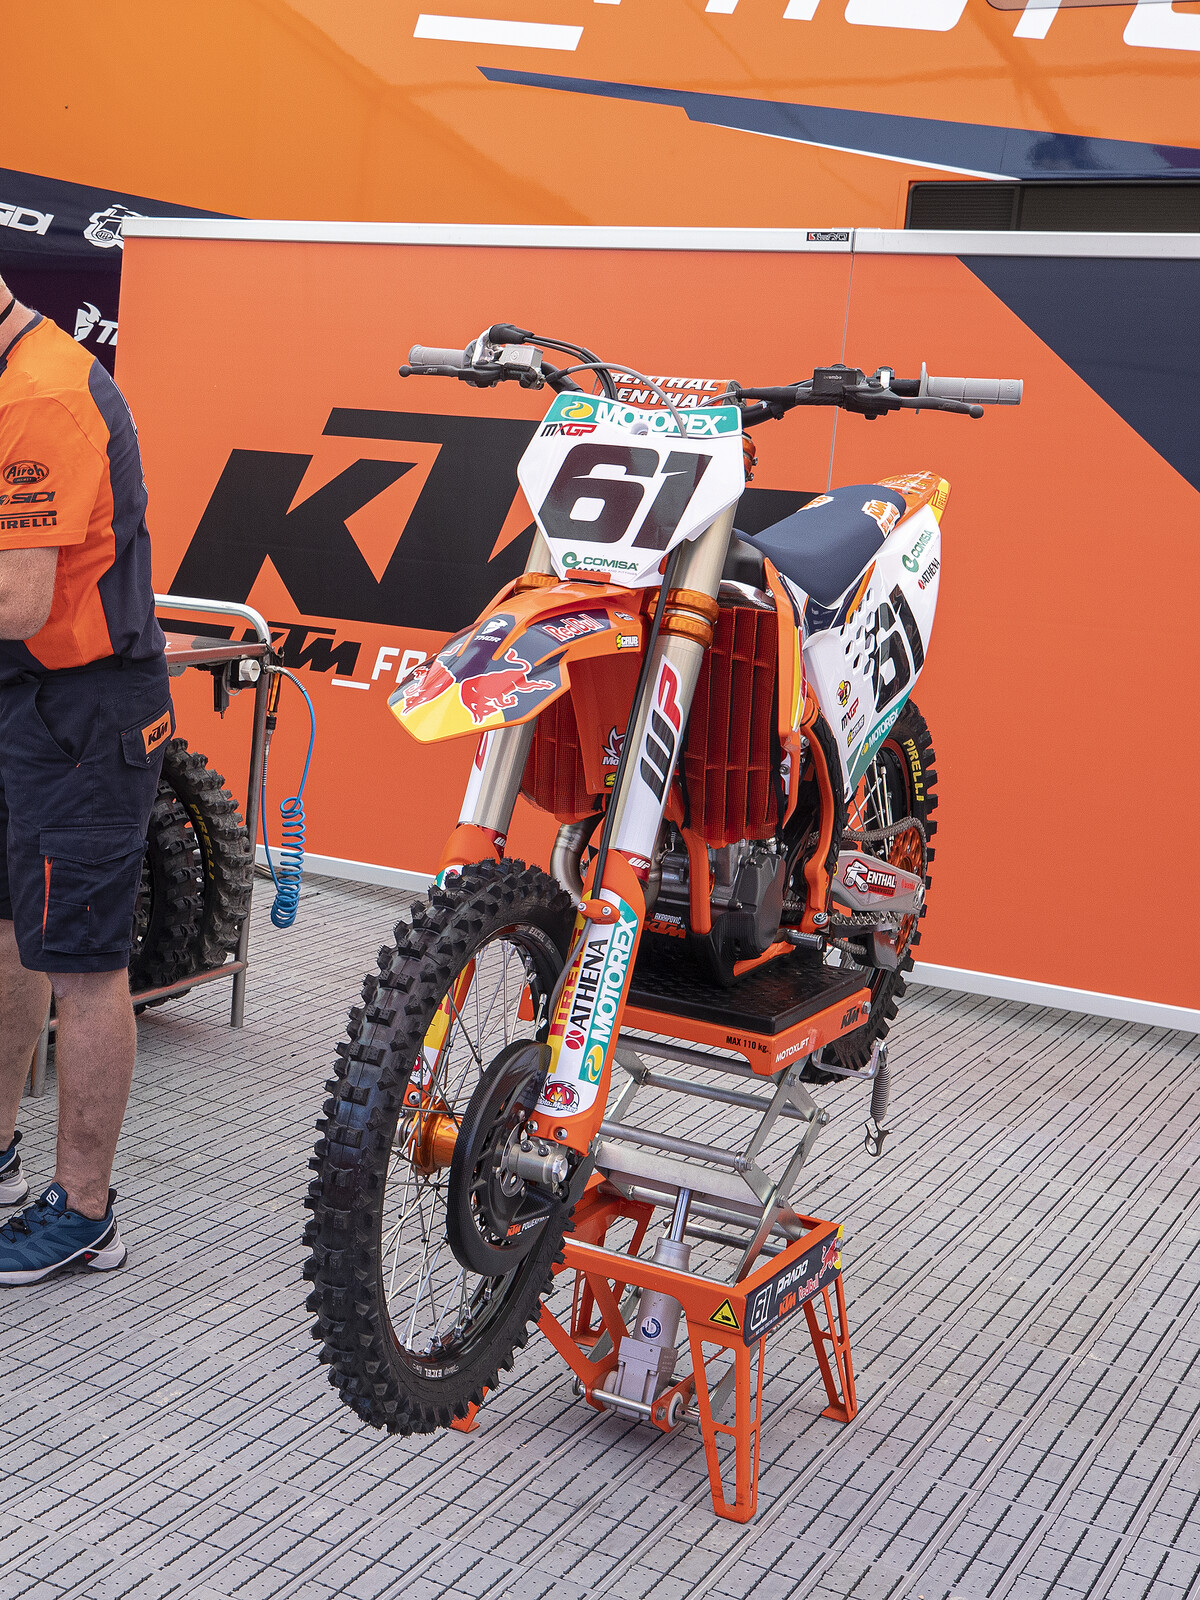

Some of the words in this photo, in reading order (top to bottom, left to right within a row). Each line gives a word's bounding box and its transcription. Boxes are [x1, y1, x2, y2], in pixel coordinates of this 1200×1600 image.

[540, 423, 597, 438] MXGP
[6, 464, 45, 480] Airoh
[538, 443, 713, 551] 61
[583, 557, 639, 571] COMISA
[474, 635, 502, 643] THOR
[542, 619, 577, 642] Red
[572, 613, 604, 633] Bull
[148, 721, 168, 746] KTM
[868, 707, 899, 747] MOTOREX
[903, 738, 925, 802] PIRELLI
[189, 804, 215, 881] PIRELLI
[571, 938, 609, 1032] ATHENA
[590, 917, 638, 1044] MOTOREX
[841, 1006, 859, 1029] KTM
[726, 1036, 742, 1046] MAX
[743, 1040, 757, 1050] 110
[775, 1259, 809, 1302] PRADO
[750, 1283, 773, 1331] 61
[779, 1291, 796, 1317] KTM
